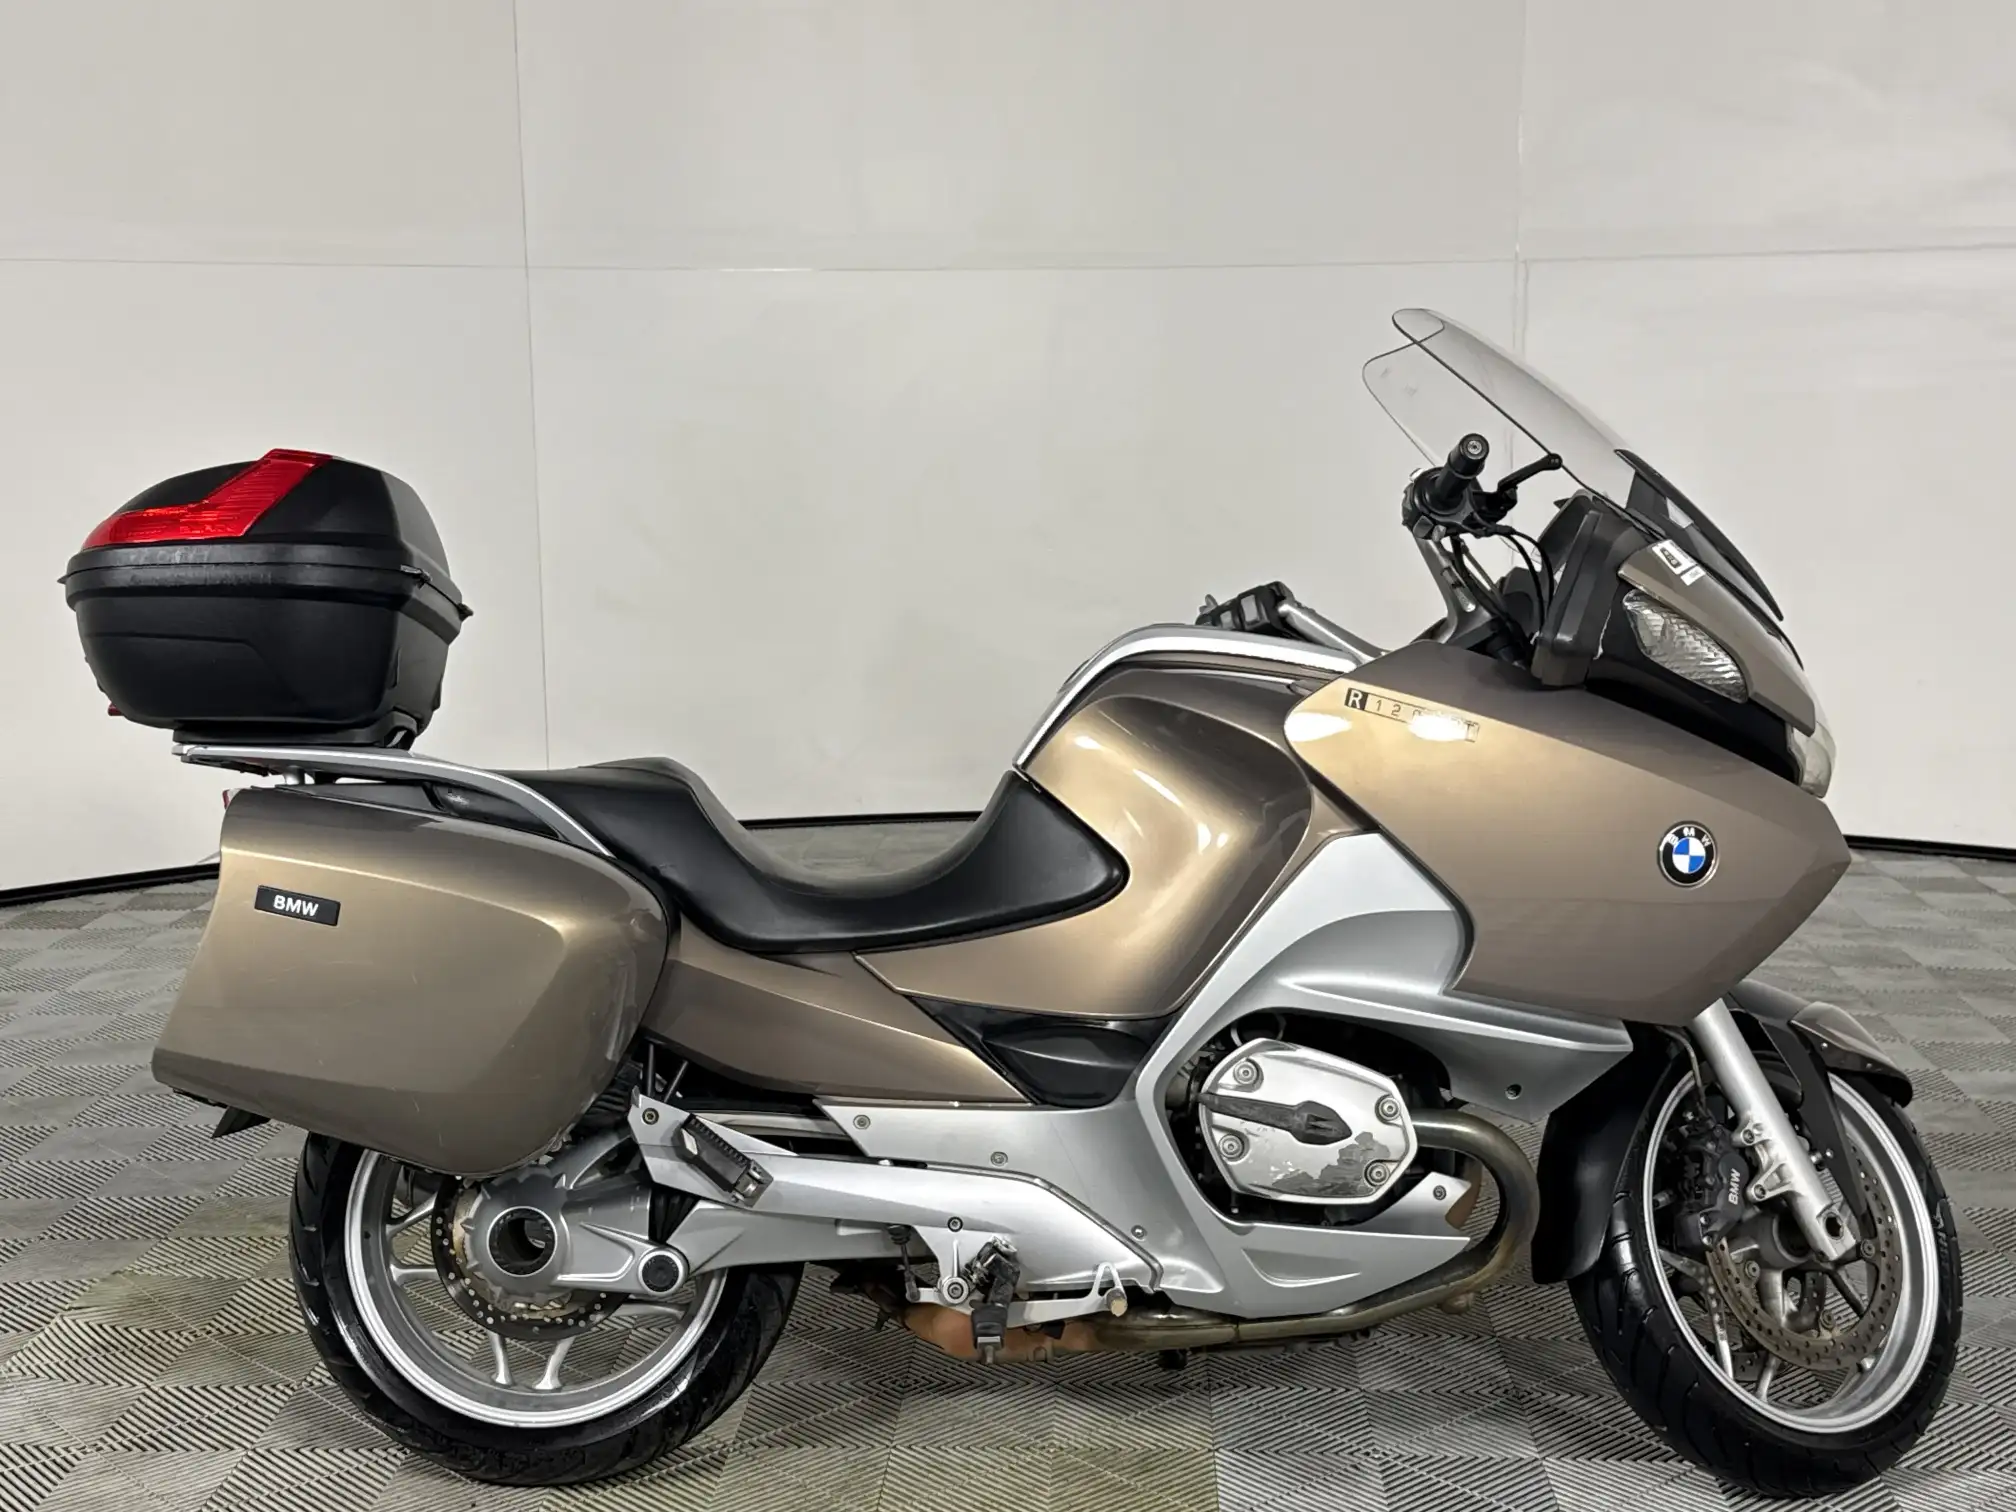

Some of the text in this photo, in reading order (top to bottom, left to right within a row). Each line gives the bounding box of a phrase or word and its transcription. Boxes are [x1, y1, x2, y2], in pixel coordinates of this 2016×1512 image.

[1347, 689, 1363, 709] R
[1666, 826, 1713, 847] BMW
[273, 894, 319, 917] BMW
[1728, 1167, 1741, 1206] BMW
